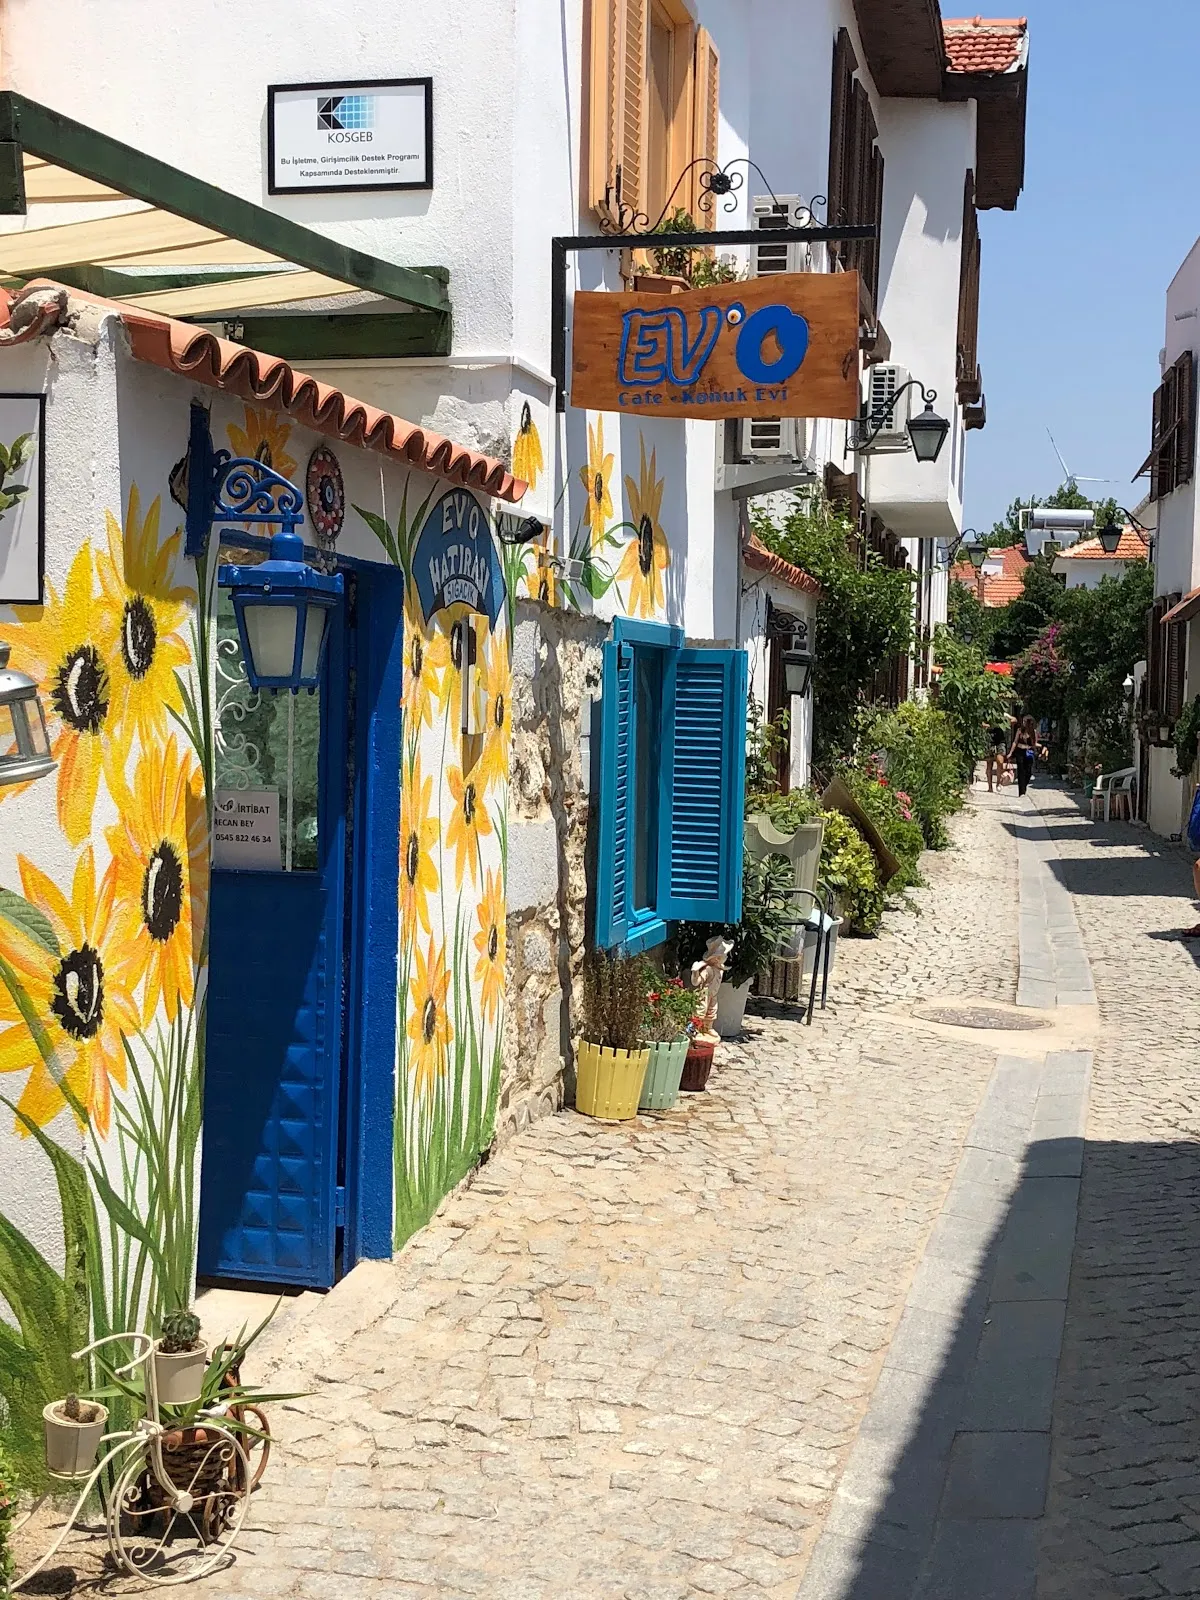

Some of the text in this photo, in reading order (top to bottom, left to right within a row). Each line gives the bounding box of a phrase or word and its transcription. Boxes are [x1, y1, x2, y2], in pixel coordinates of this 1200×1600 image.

[327, 131, 373, 144] KOSGEB
[292, 156, 319, 166] İşletme,
[320, 155, 360, 164] Girişimcilik
[361, 154, 386, 162] Destek
[387, 153, 420, 162] Programı
[299, 166, 400, 178] Kapsamında Desteklenmiştir.
[618, 390, 663, 407] Cafe
[682, 387, 748, 405] Konuk
[755, 386, 788, 402] Evi
[238, 803, 270, 814] İRTİBAT
